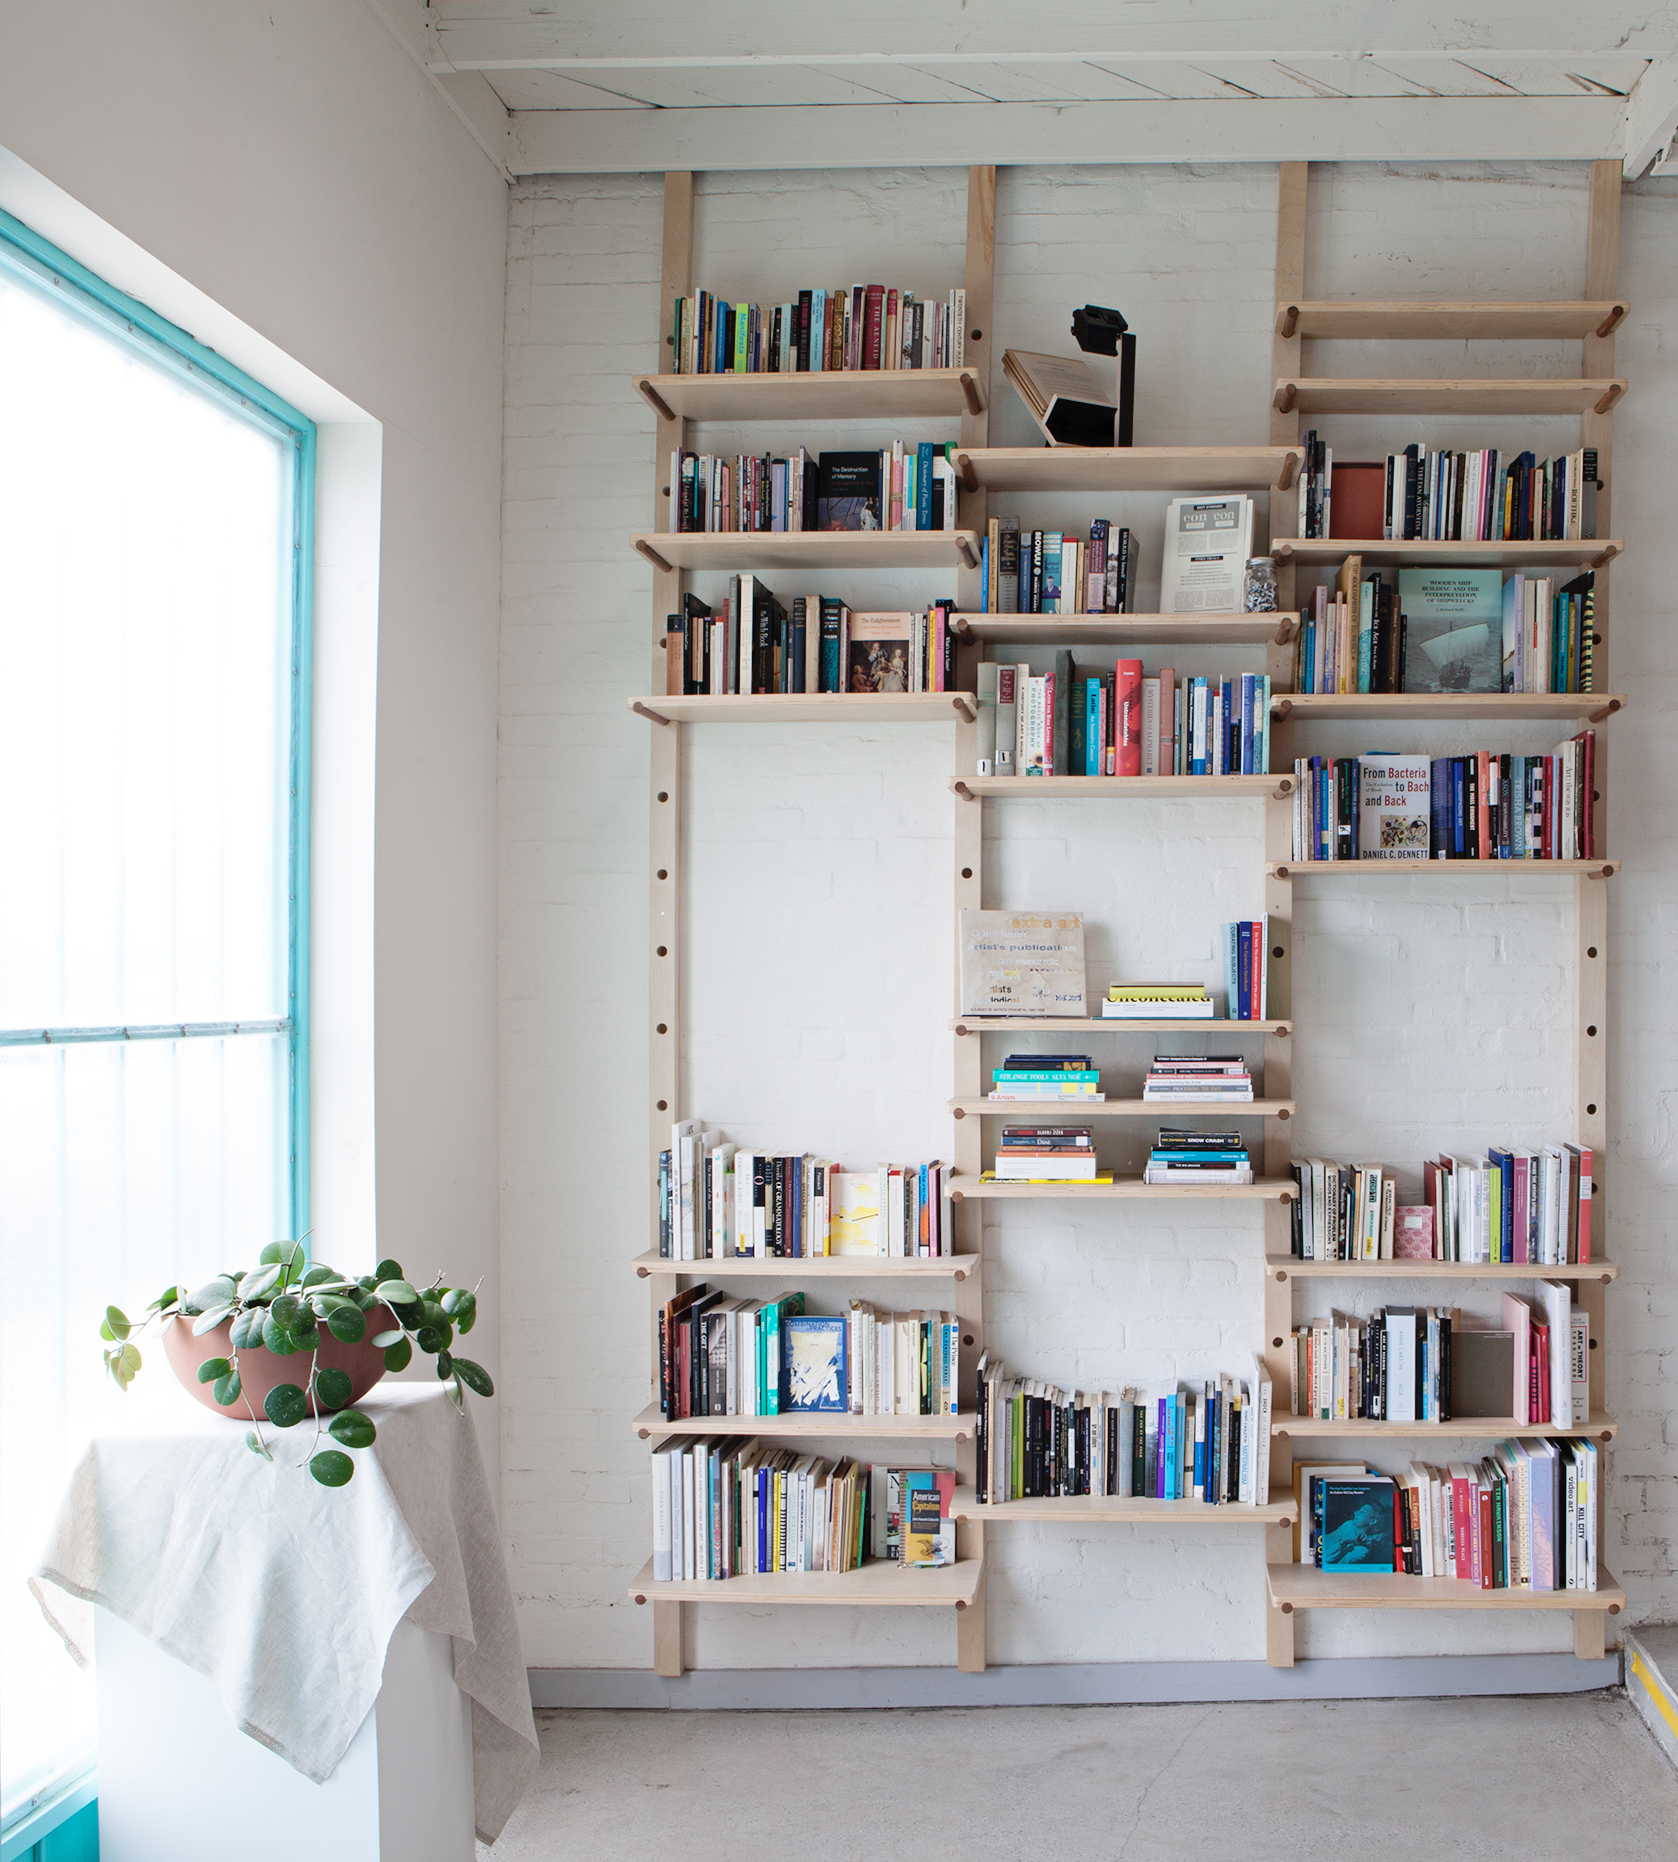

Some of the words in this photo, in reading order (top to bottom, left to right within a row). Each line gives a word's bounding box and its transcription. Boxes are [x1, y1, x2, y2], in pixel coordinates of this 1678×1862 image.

[738, 313, 747, 354] Manifesta
[1570, 489, 1578, 525] ROETHKE
[1214, 511, 1234, 520] eon
[1034, 532, 1042, 566] BEOWULF
[760, 617, 768, 632] Witch
[759, 633, 768, 647] Book
[1364, 768, 1385, 778] From
[1388, 768, 1426, 778] Bacteria
[1395, 782, 1404, 792] to
[1408, 782, 1429, 792] Bach
[1365, 796, 1381, 806] and
[1385, 796, 1407, 806] Back
[1514, 779, 1522, 813] TRISHA
[1514, 816, 1522, 850] BROWN
[1363, 850, 1387, 858] DANIEL
[1389, 850, 1396, 858] C.
[1398, 850, 1428, 858] DENNETT
[1012, 917, 1052, 928] extra
[1058, 917, 1080, 928] art
[775, 1182, 782, 1190] OF
[913, 1492, 940, 1501] American
[912, 1501, 940, 1510] Capitalism
